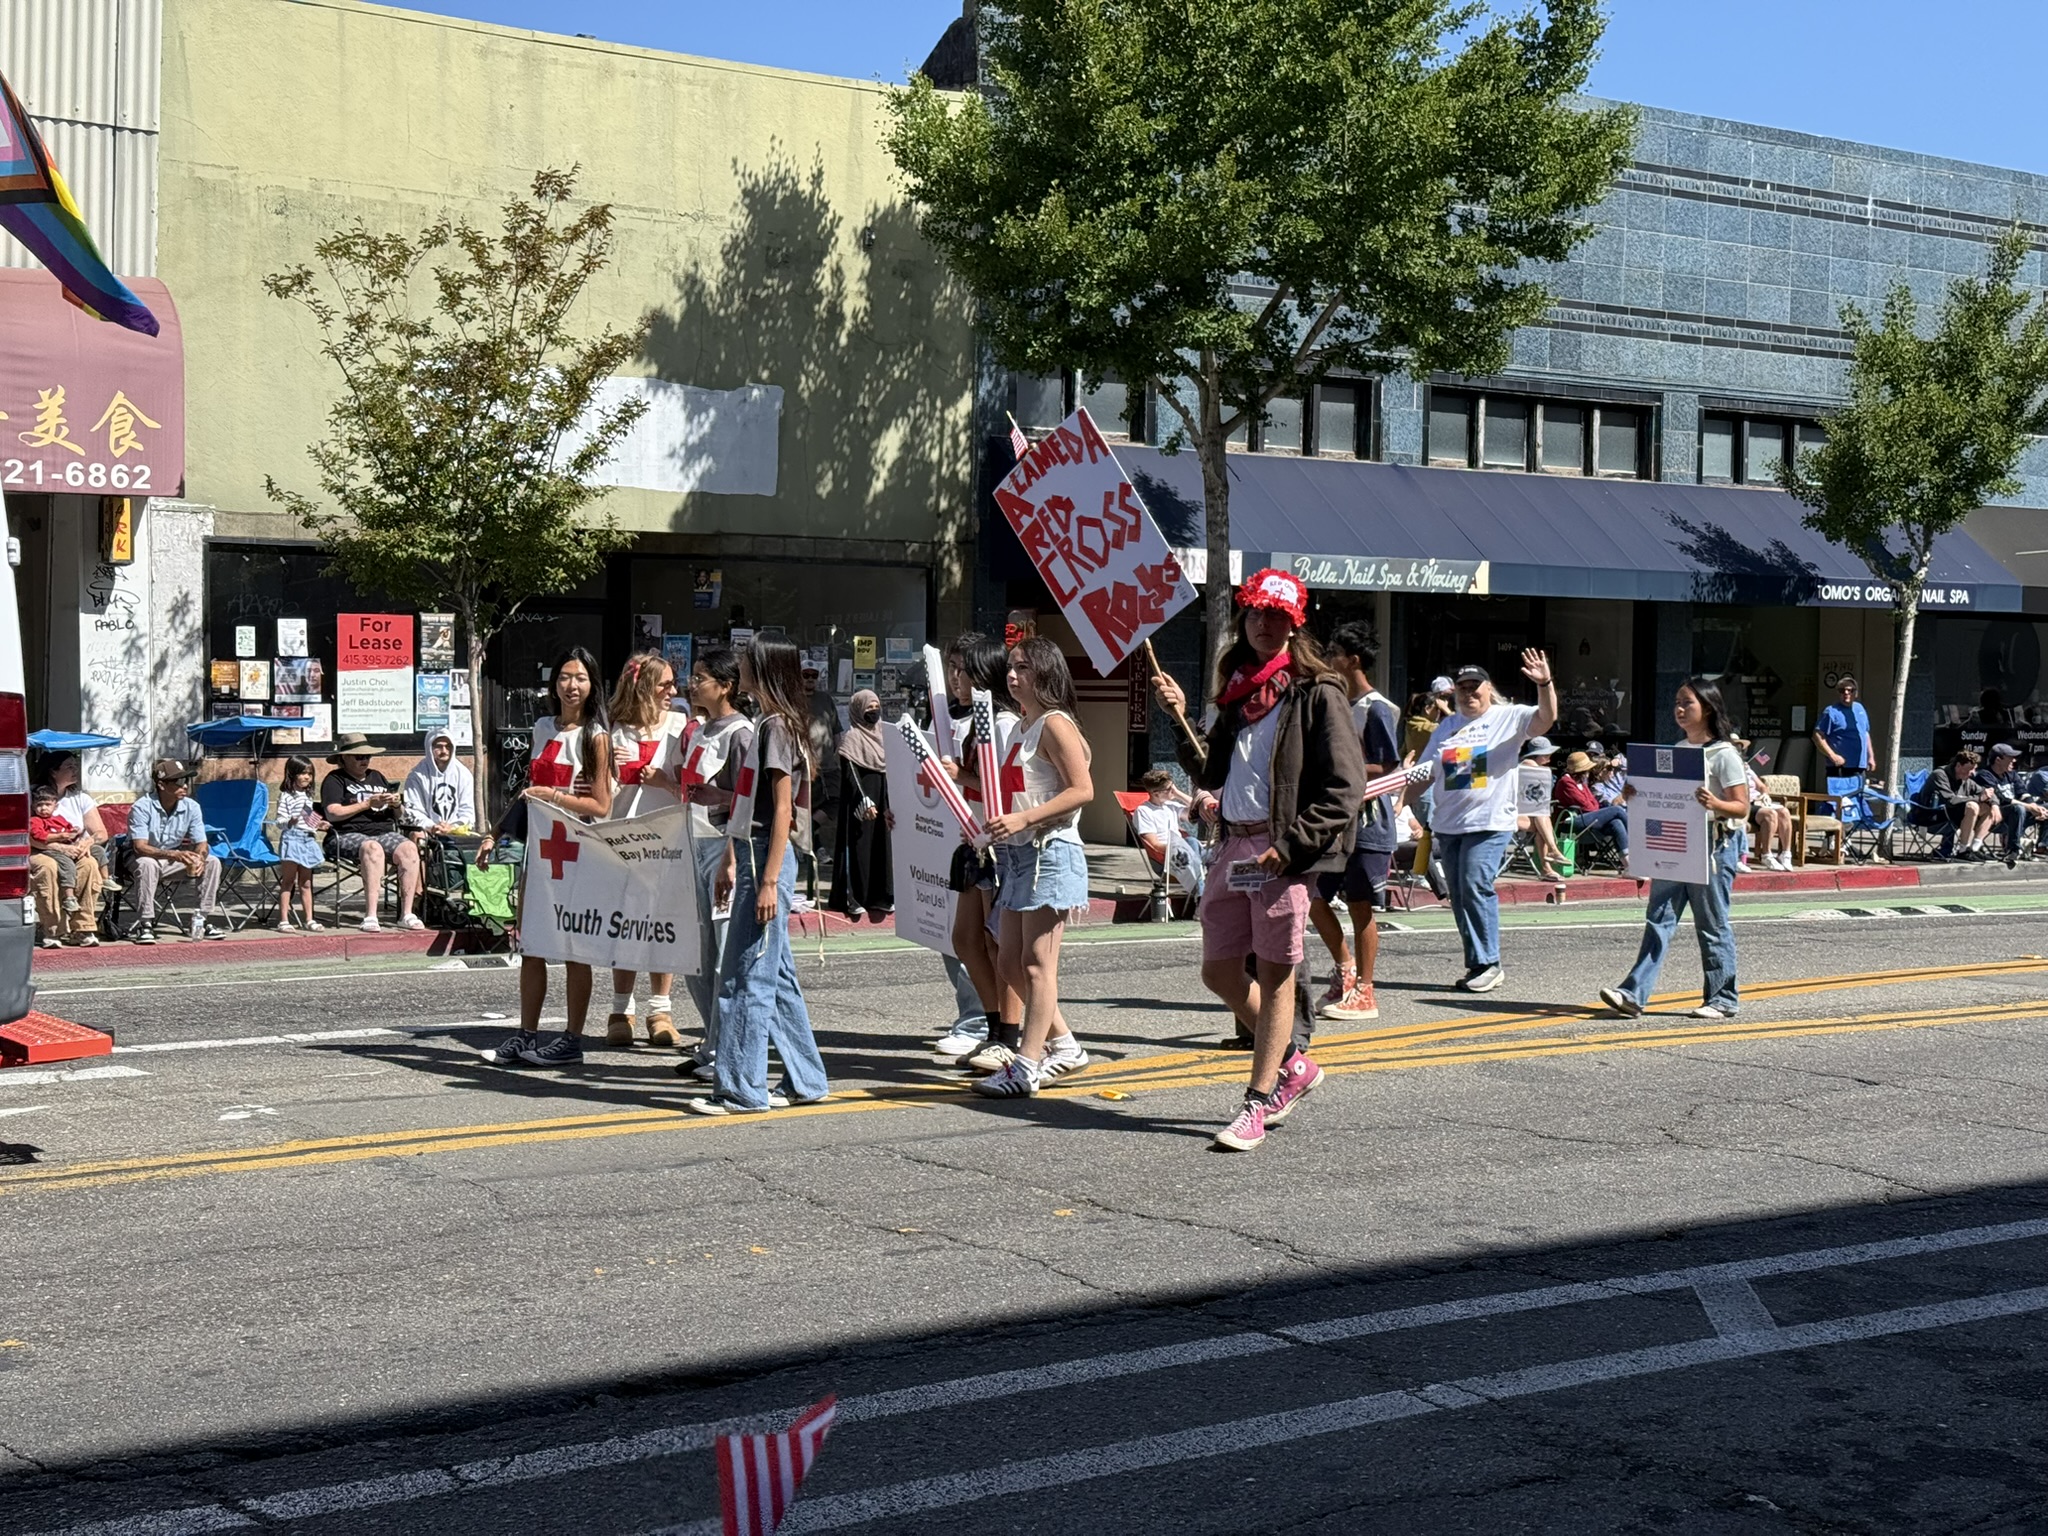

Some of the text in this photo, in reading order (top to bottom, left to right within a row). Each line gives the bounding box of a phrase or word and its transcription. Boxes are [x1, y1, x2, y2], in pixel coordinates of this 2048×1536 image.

[0, 384, 162, 459] 美食
[995, 408, 1110, 533] ALAMEDA
[1019, 494, 1075, 566] RED
[1039, 482, 1142, 608] CROSS
[1294, 556, 1468, 592] Bella Nail Spa & Waxing
[1818, 584, 1861, 601] TOMO'S
[1922, 589, 1946, 603] NAIL
[1949, 590, 1970, 604] SPA
[1079, 552, 1182, 662] ROCKS
[95, 619, 135, 632] PABLO
[360, 617, 392, 633] For
[349, 635, 403, 650] Lease
[857, 639, 873, 647] IMP
[342, 654, 409, 666] 415.395.7262
[341, 678, 367, 687] Justin
[399, 722, 411, 730] JLL
[1961, 730, 1988, 742] Sunday
[2028, 743, 2045, 754] 7 pm
[1664, 793, 1696, 802] AMERICA
[915, 813, 944, 829] American
[915, 823, 944, 839] Red Cross
[604, 834, 631, 847] Red
[628, 832, 662, 842] Cross
[618, 850, 641, 862] Bay
[642, 847, 660, 859] Area
[910, 864, 951, 889] Voluntee
[553, 903, 677, 944] Youth Services
